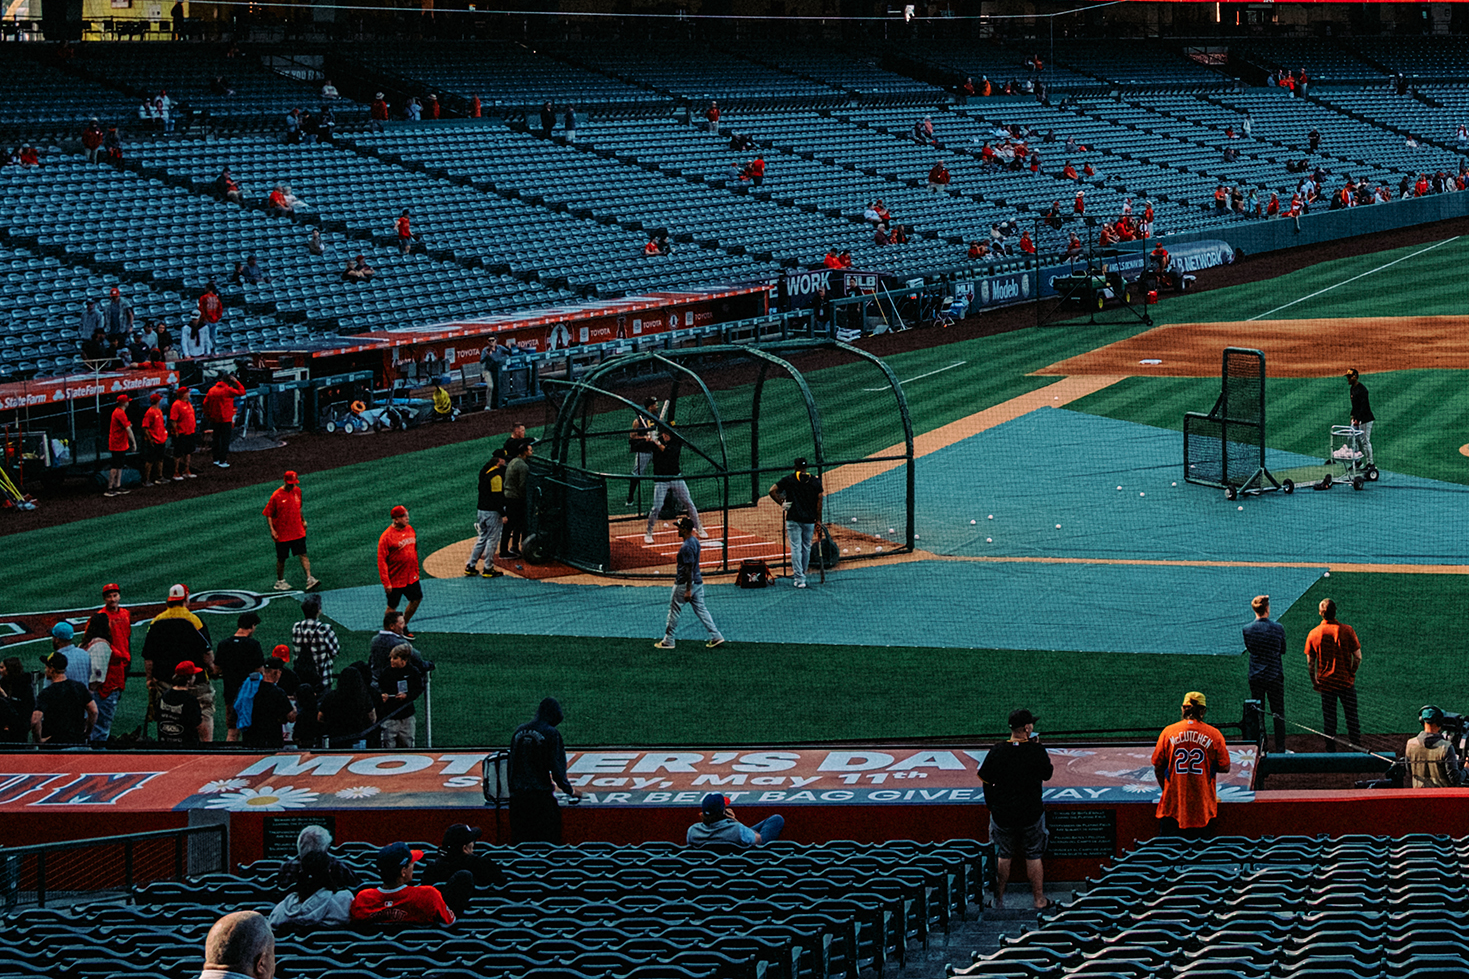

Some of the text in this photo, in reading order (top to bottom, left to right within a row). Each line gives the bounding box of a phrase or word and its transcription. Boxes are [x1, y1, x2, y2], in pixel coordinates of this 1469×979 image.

[992, 278, 1019, 300] Modelo
[643, 320, 662, 329] TOYOTA
[590, 328, 610, 337] TOYOTA
[456, 350, 480, 359] TOYOTA
[236, 752, 801, 776] MOTER'S
[1174, 748, 1205, 774] 22
[691, 773, 823, 788] May
[838, 771, 929, 785] 11th
[758, 790, 855, 802] BAG
